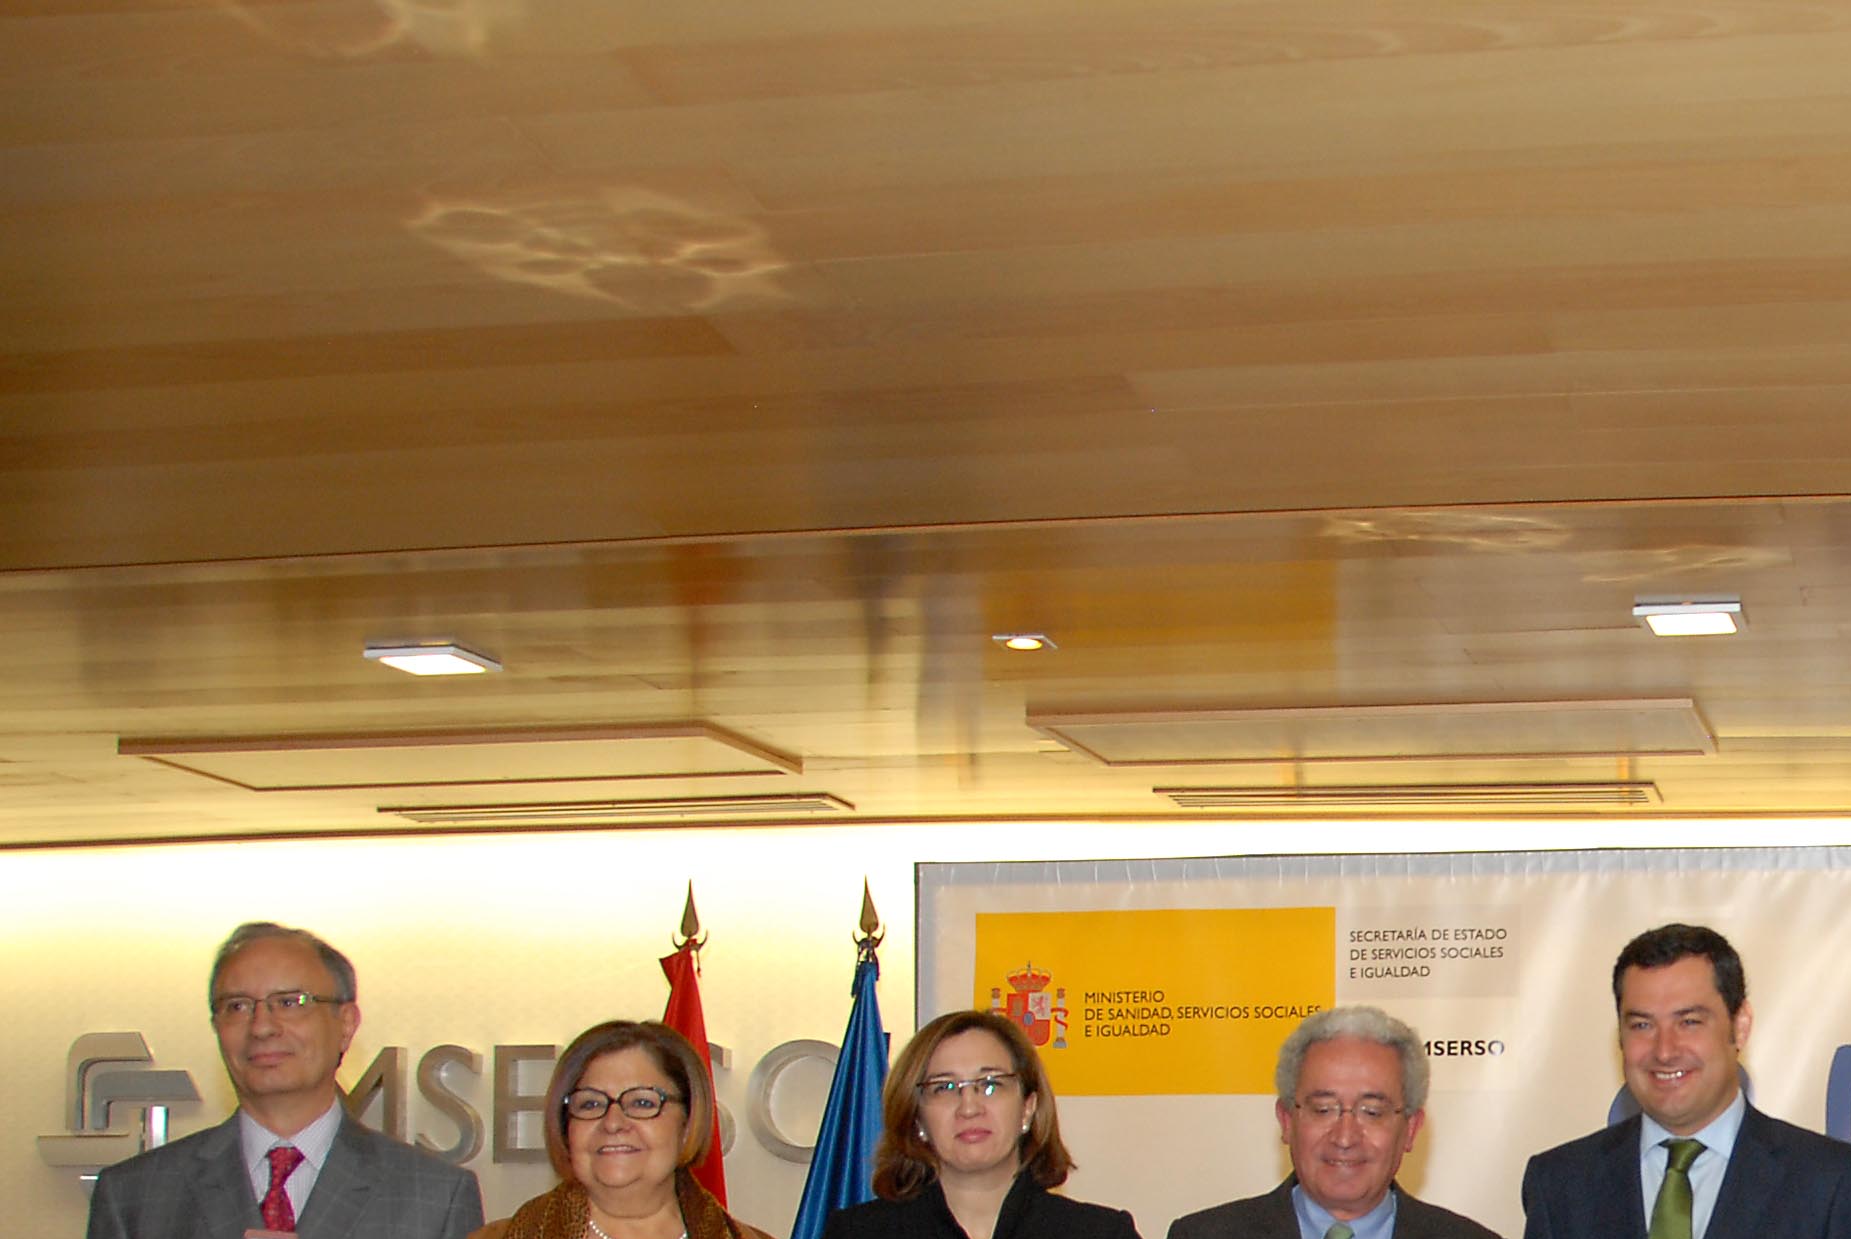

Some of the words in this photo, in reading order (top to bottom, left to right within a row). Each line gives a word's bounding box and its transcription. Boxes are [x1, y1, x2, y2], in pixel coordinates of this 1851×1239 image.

[1350, 926, 1426, 942] SECRETARÍA
[1431, 929, 1449, 941] DE
[1454, 928, 1507, 941] ESTADO
[1350, 949, 1367, 961] DE
[1371, 947, 1436, 961] SERVICIOS
[1440, 946, 1504, 959] SOCIALES
[1350, 967, 1356, 979] E
[1360, 966, 1430, 979] IGUALDAD
[1085, 990, 1164, 1004] MINISTERIO
[1085, 1008, 1103, 1021] DE
[1107, 1007, 1174, 1021] SANIDAD,
[1177, 1006, 1249, 1020] SERVICIOS
[1085, 1025, 1091, 1037] E
[1096, 1024, 1170, 1037] IGUALDAD
